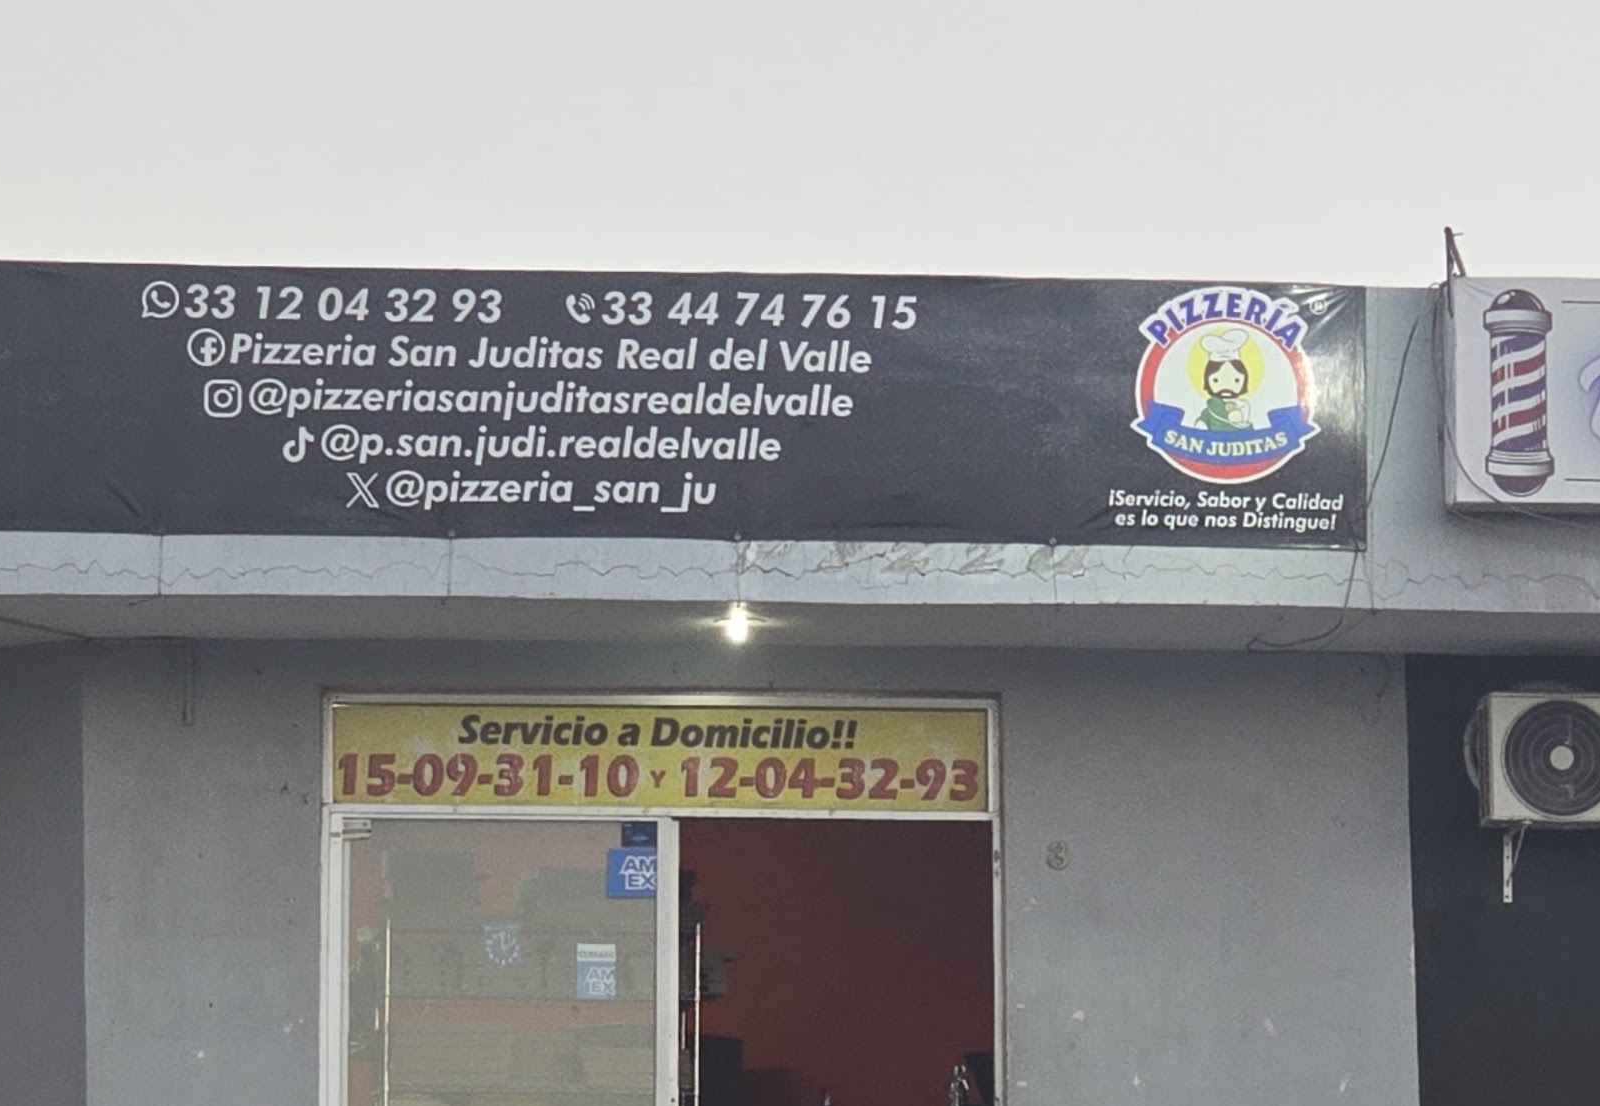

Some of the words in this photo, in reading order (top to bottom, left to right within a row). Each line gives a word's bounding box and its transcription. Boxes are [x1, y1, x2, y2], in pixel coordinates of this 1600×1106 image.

[183, 284, 236, 320] 33
[255, 286, 303, 320] 12
[318, 287, 369, 321] 04
[384, 288, 437, 323] 32
[451, 288, 503, 324] 93
[601, 291, 653, 325] 33
[667, 292, 719, 325] 44
[735, 292, 786, 327] 74
[801, 294, 852, 329] 76
[871, 295, 918, 330] 15
[1146, 292, 1302, 350] PIZZERÍA
[229, 332, 377, 367] Pizzeria
[387, 335, 457, 368] San
[468, 334, 603, 371] Juditas
[616, 337, 698, 370] Real
[709, 337, 768, 372] del
[780, 340, 873, 374] Valle
[248, 377, 854, 421] @pizzeriasanjuditasrealdelvalle
[319, 422, 782, 466] @p.san.judi.realdelvalle
[1163, 429, 1205, 454] SAN
[1206, 431, 1288, 457] JUDITAS
[385, 469, 717, 513] @pizzeria_san_ju
[1108, 489, 1191, 510] ¡Servicio,
[1196, 491, 1250, 509] Sabor
[1255, 494, 1266, 512] y
[1272, 493, 1344, 511] Calidad
[1114, 514, 1136, 526] es
[1141, 510, 1158, 526] lo
[1164, 513, 1199, 531] que
[1204, 514, 1237, 528] nos
[1242, 511, 1337, 533] Distingue!
[458, 714, 609, 746] Servicio
[617, 721, 641, 746] a
[650, 717, 858, 750] Domicilio!!
[338, 753, 640, 798] 15-09-31-10
[650, 770, 666, 788] Y
[680, 756, 980, 801] 12-04-32-93
